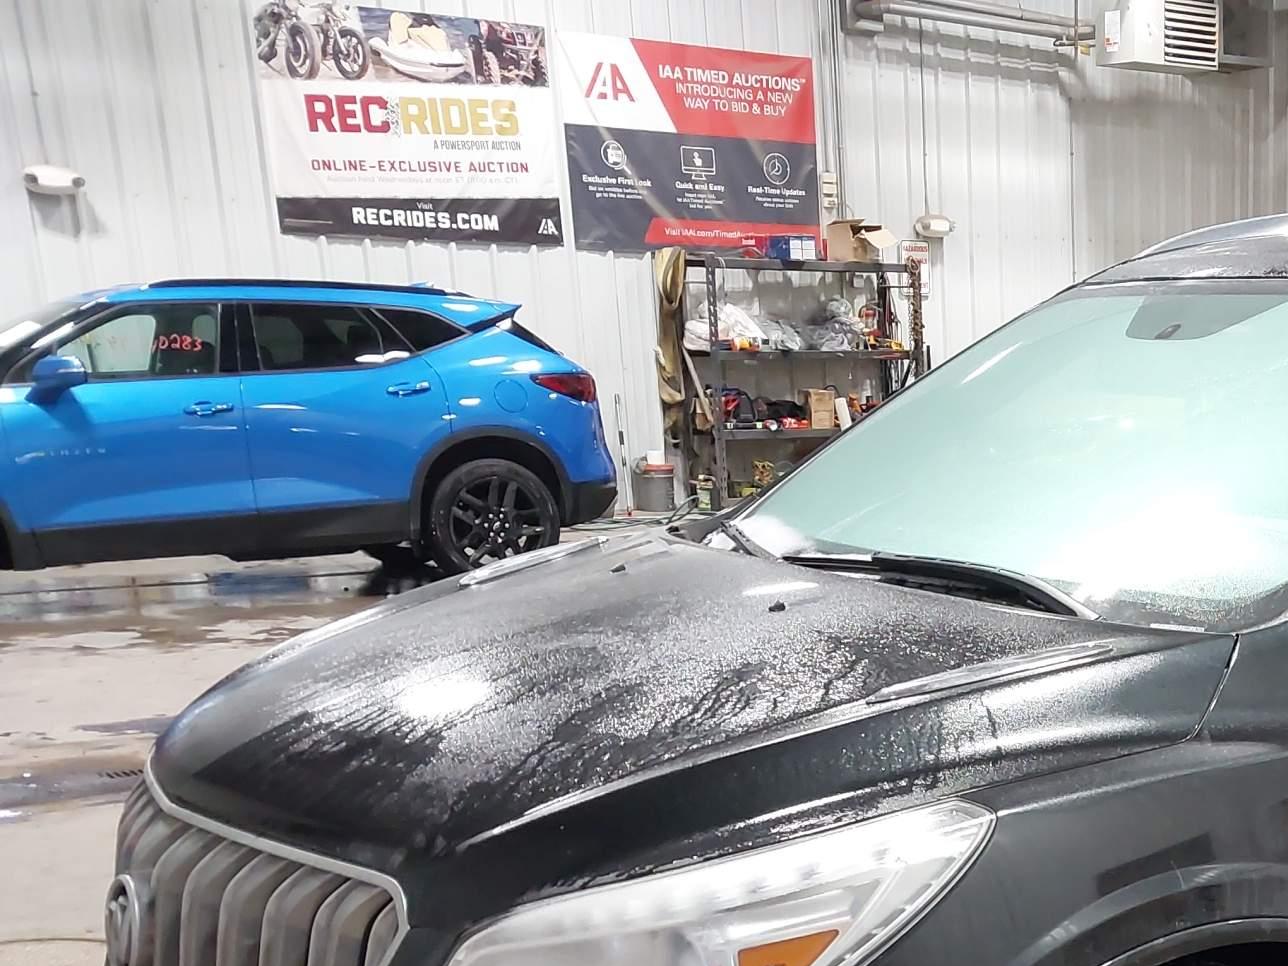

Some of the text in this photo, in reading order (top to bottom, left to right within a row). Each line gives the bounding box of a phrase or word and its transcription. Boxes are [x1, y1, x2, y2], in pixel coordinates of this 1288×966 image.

[658, 64, 683, 80] IAA
[684, 67, 729, 84] TIMED
[675, 82, 793, 104] INTRODUCING A NEW
[683, 96, 786, 117] WAY TO BID & BUY
[303, 94, 520, 136] REC RIDES
[433, 140, 521, 151] A POWERSPORT AUCTION
[311, 159, 529, 173] ONLINE-EXCLUSIVE AUCTION
[582, 174, 652, 187] Exclusive First Look
[675, 181, 694, 190] Quick
[709, 183, 725, 193] Easy
[748, 186, 806, 196] Real-Time Updates
[416, 201, 433, 209] Visit
[352, 206, 500, 231] RECRIDES.COM
[664, 228, 681, 236] Visit
